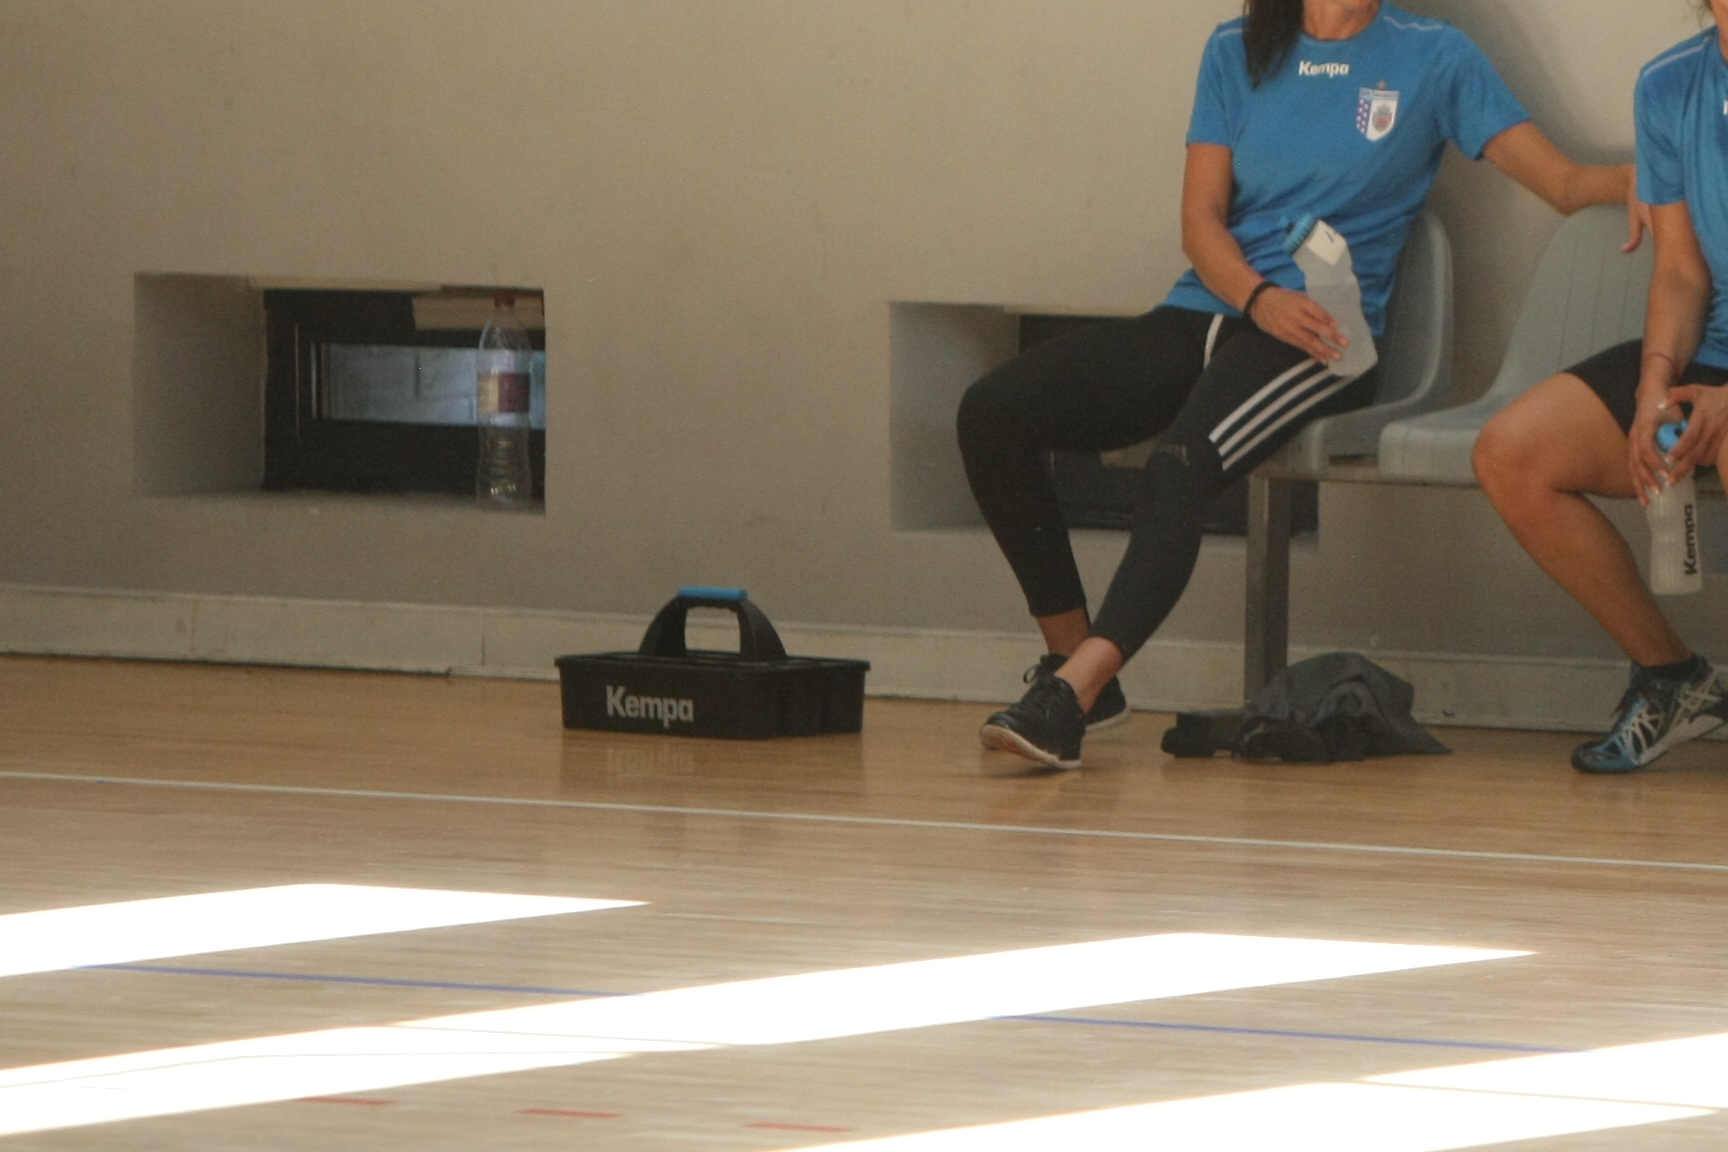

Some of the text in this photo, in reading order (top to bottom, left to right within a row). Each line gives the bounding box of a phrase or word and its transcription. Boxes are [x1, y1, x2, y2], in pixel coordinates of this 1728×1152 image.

[1298, 60, 1349, 78] Kempa
[1683, 503, 1698, 576] Kempa
[606, 685, 694, 728] Kempa
